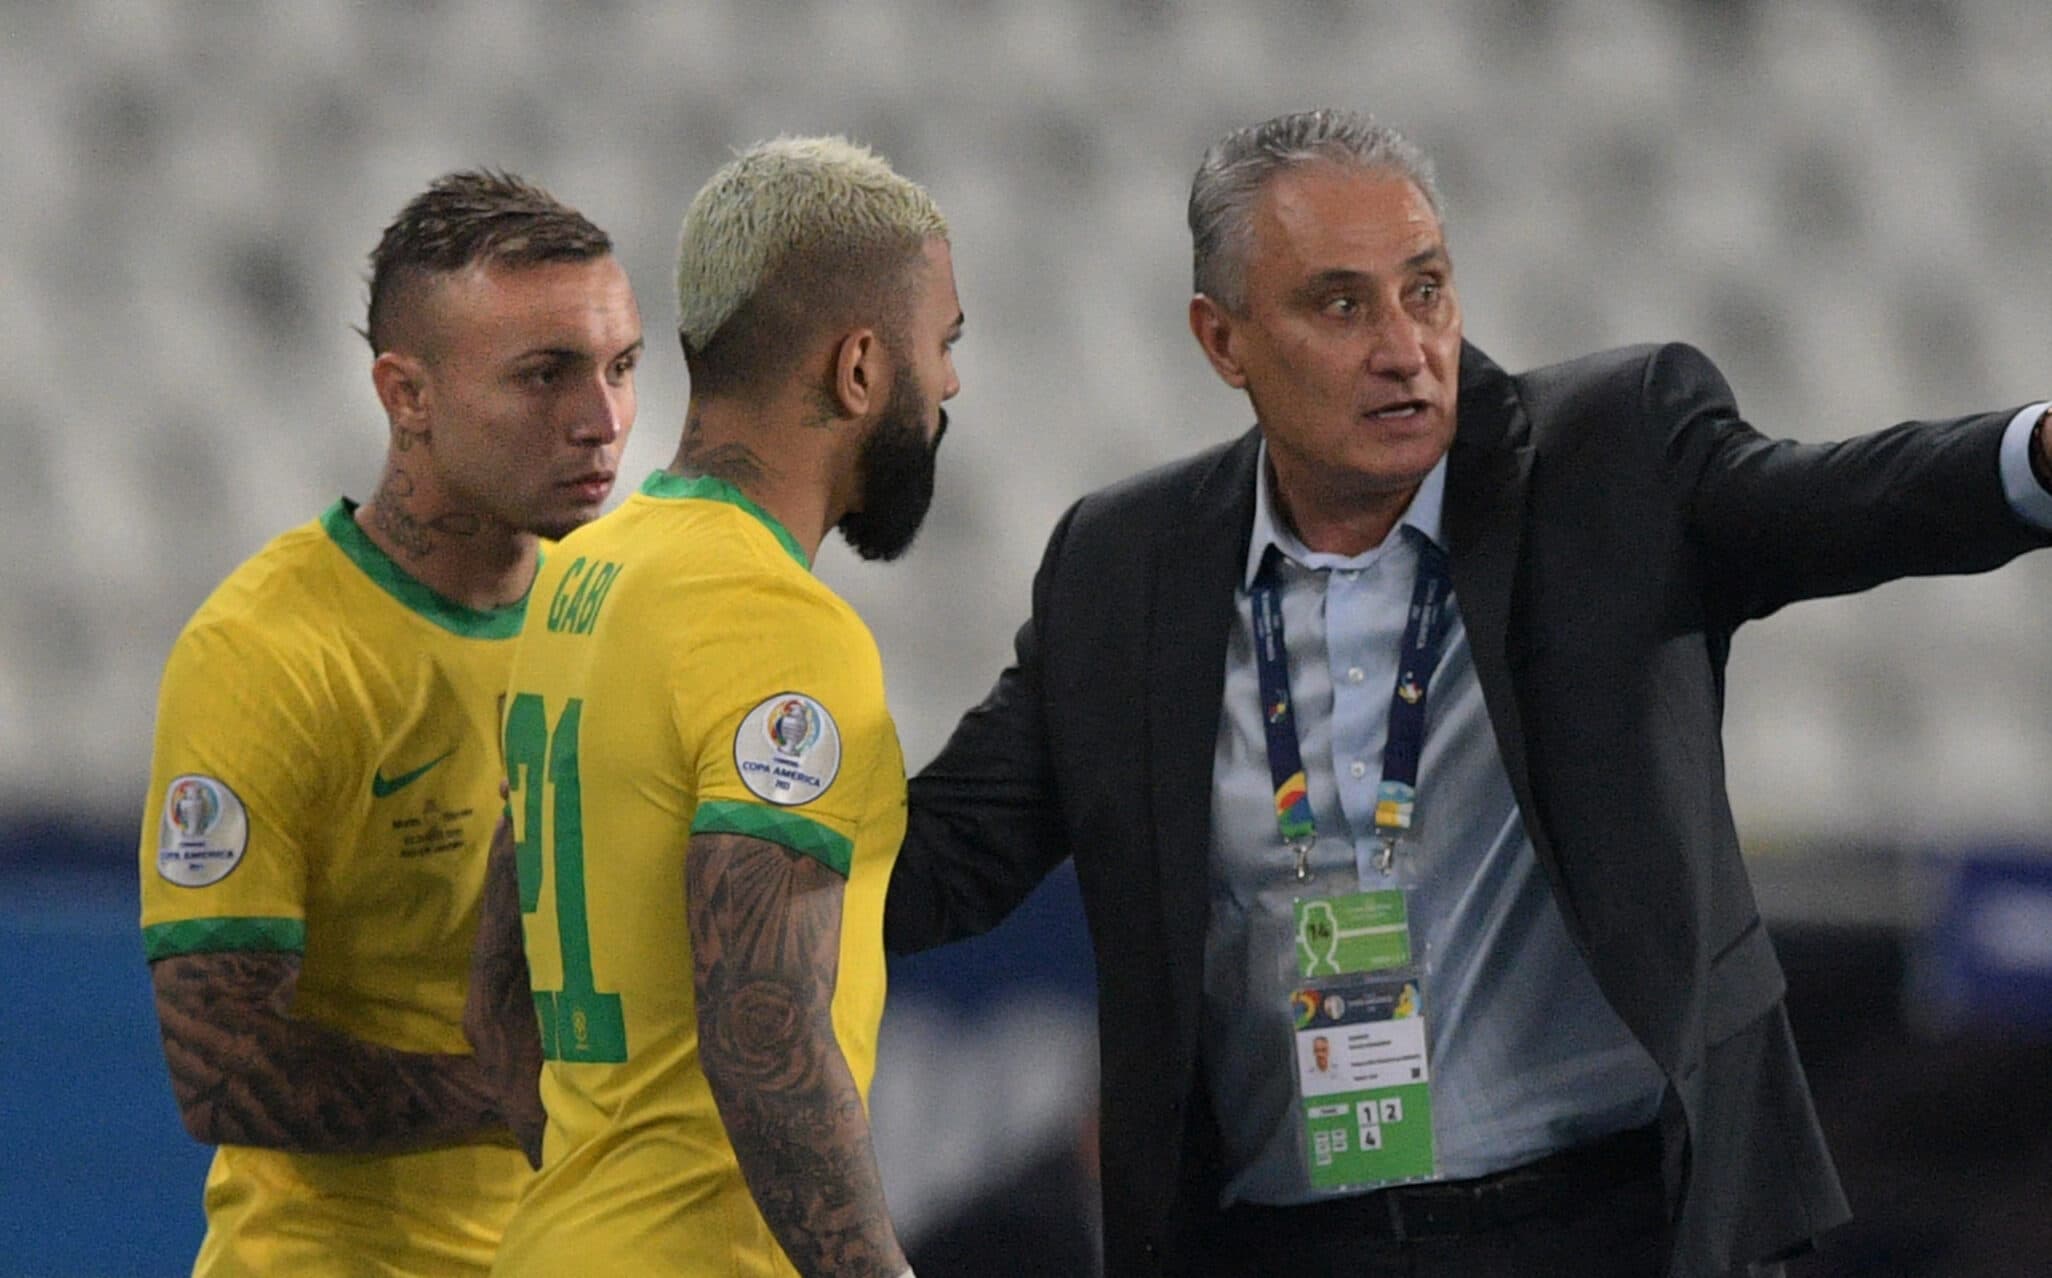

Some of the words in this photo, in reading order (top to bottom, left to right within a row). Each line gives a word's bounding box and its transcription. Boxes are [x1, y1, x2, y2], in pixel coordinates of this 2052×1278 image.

[547, 556, 623, 636] GABI
[742, 760, 770, 773] COPA
[504, 692, 629, 1063] 21
[1363, 1106, 1372, 1123] 1
[1385, 1103, 1397, 1121] 2
[1365, 1130, 1377, 1146] 4
